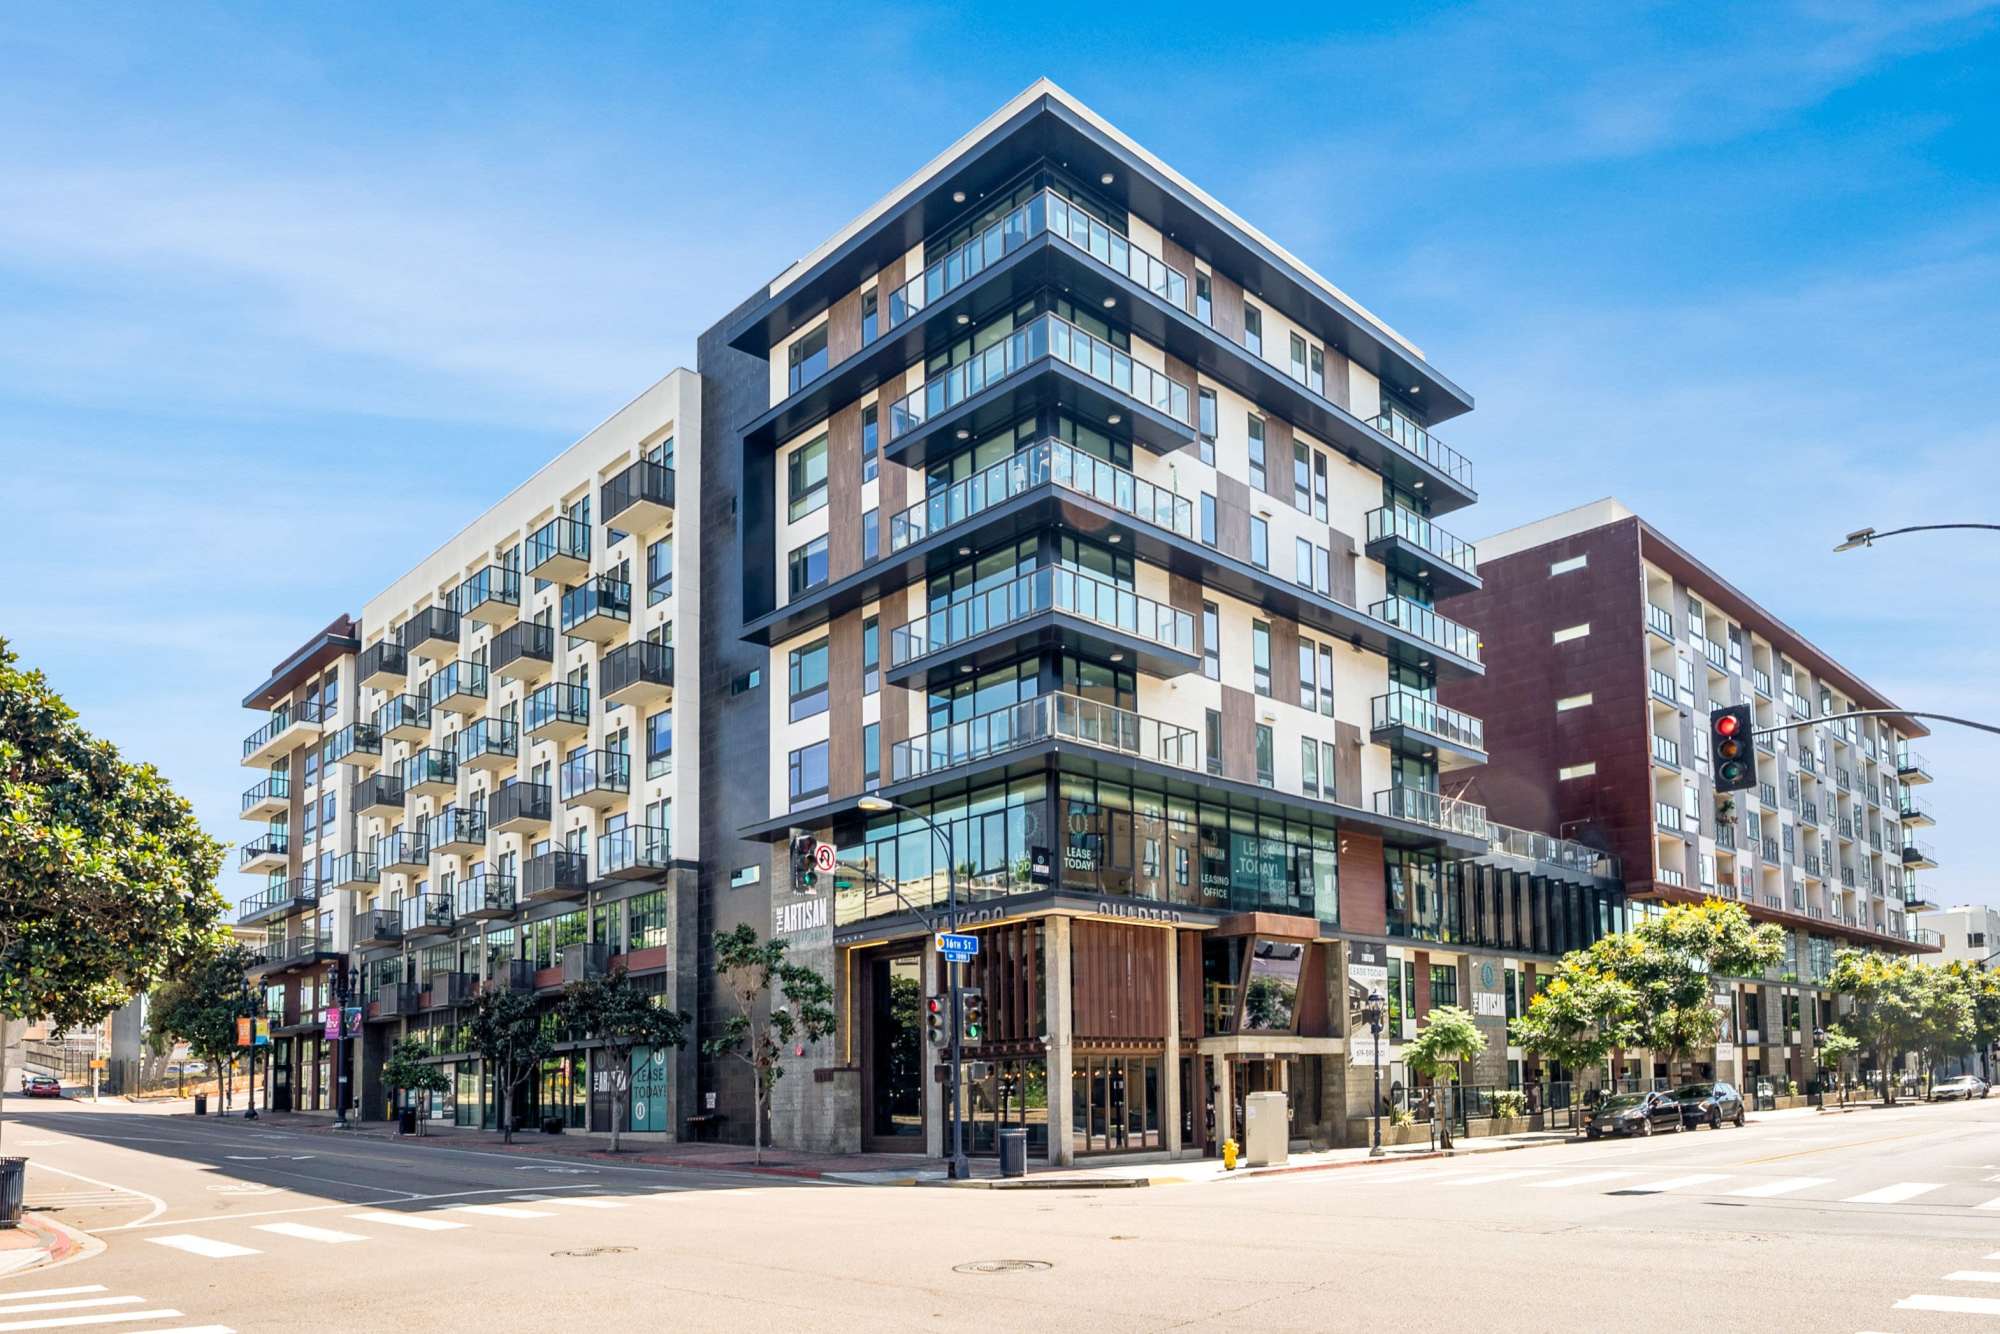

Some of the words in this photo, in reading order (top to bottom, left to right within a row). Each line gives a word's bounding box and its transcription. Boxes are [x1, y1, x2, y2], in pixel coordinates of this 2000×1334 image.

[1066, 846, 1092, 860] LEASE
[1064, 858, 1094, 872] TODAY!
[1201, 873, 1230, 887] LEASING
[1203, 887, 1228, 899] OFFICE
[776, 906, 784, 936] THE
[783, 897, 828, 934] ARTISAN
[637, 1067, 664, 1082] LEASE
[634, 1085, 668, 1099] TODAY!
